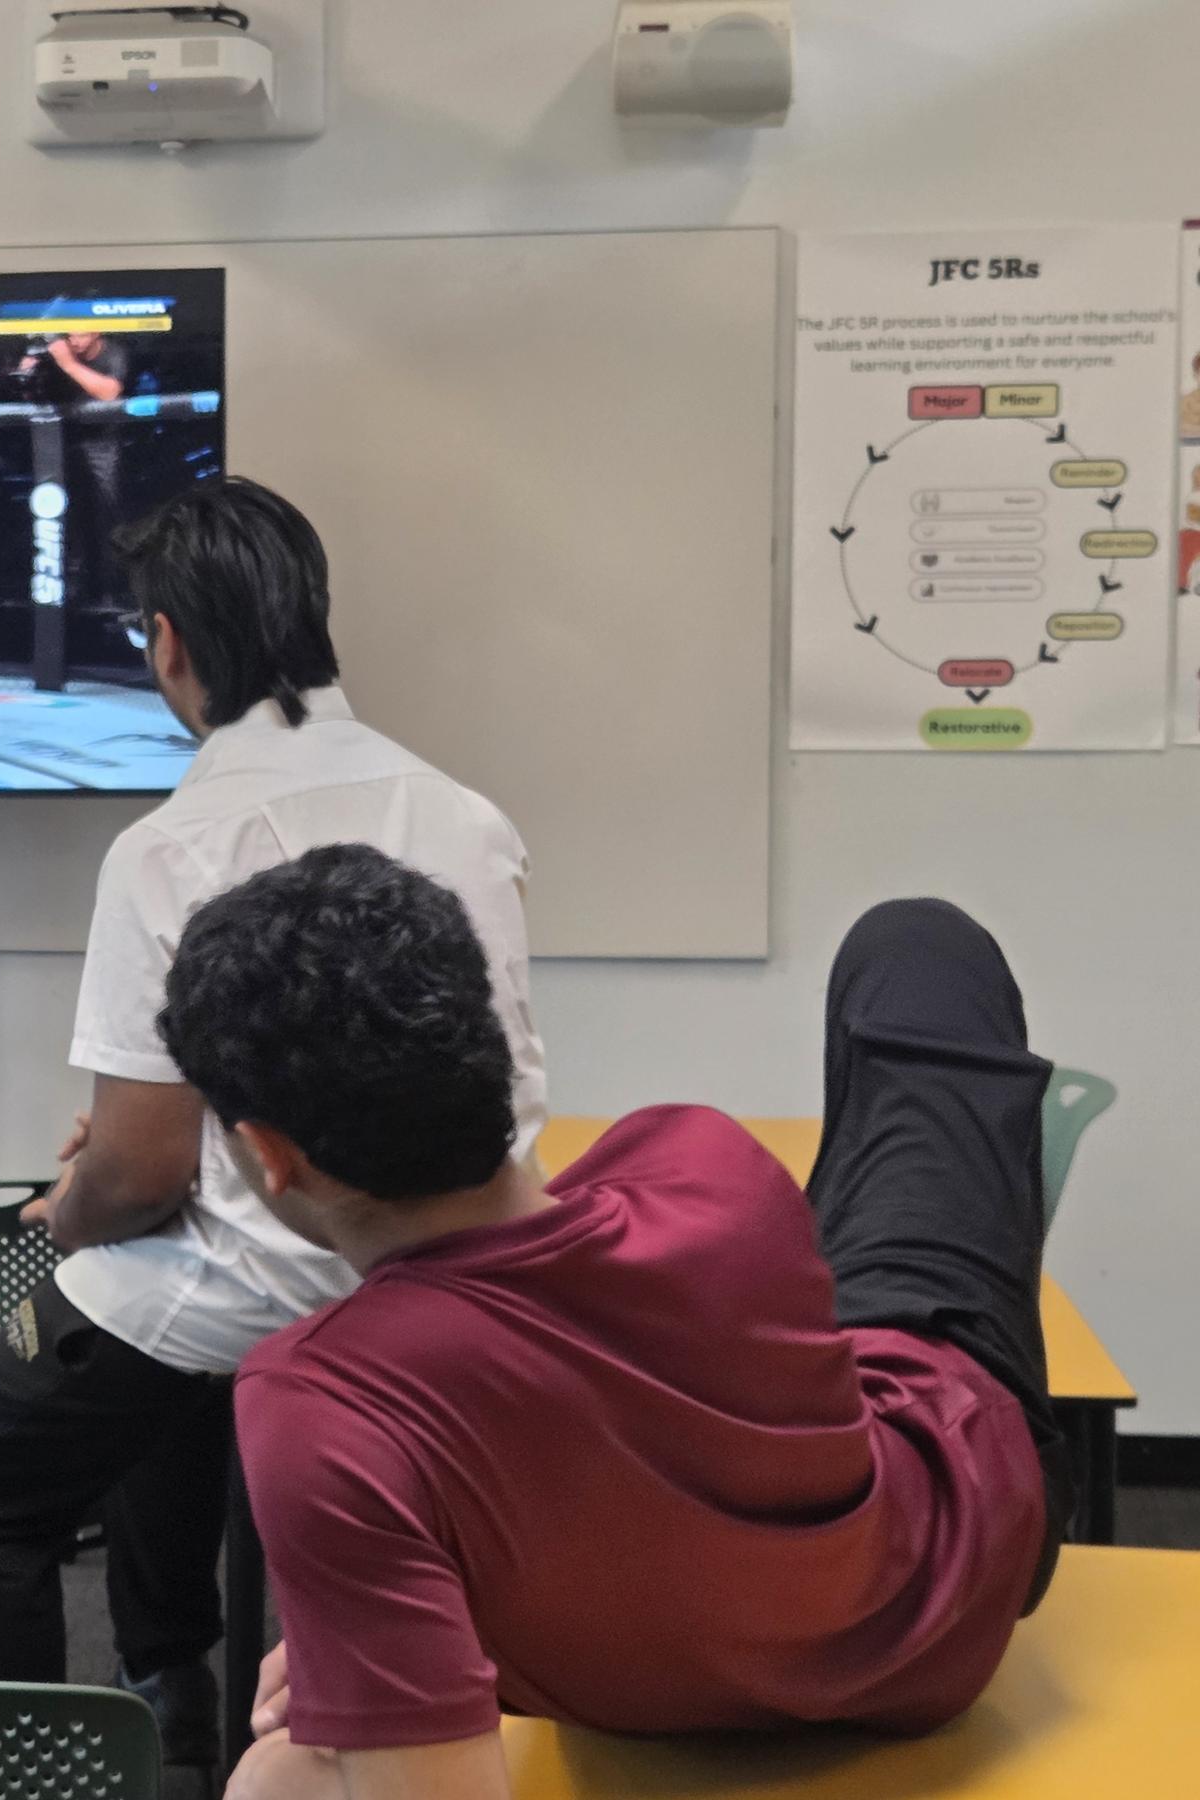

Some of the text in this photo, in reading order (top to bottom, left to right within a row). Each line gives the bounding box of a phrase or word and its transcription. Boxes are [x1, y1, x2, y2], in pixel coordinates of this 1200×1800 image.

[121, 51, 156, 60] EPSON
[928, 258, 1040, 286] JFC 5Rs
[828, 317, 856, 330] JFC
[882, 317, 942, 331] process
[945, 315, 957, 328] is
[960, 314, 997, 328] used
[1001, 314, 1017, 326] to
[1021, 314, 1079, 326] nurture
[1083, 311, 1108, 324] the
[813, 339, 862, 352] values
[866, 337, 905, 350] while
[909, 336, 992, 352] supporting
[1009, 334, 1041, 348] safe
[1044, 334, 1073, 347] and
[1077, 331, 1155, 346] respectful
[850, 360, 912, 374] learning
[914, 356, 1012, 371] environment
[1016, 355, 1037, 368] for
[923, 395, 968, 409] Major
[999, 393, 1043, 406] Minor
[929, 720, 1022, 735] Restorative
